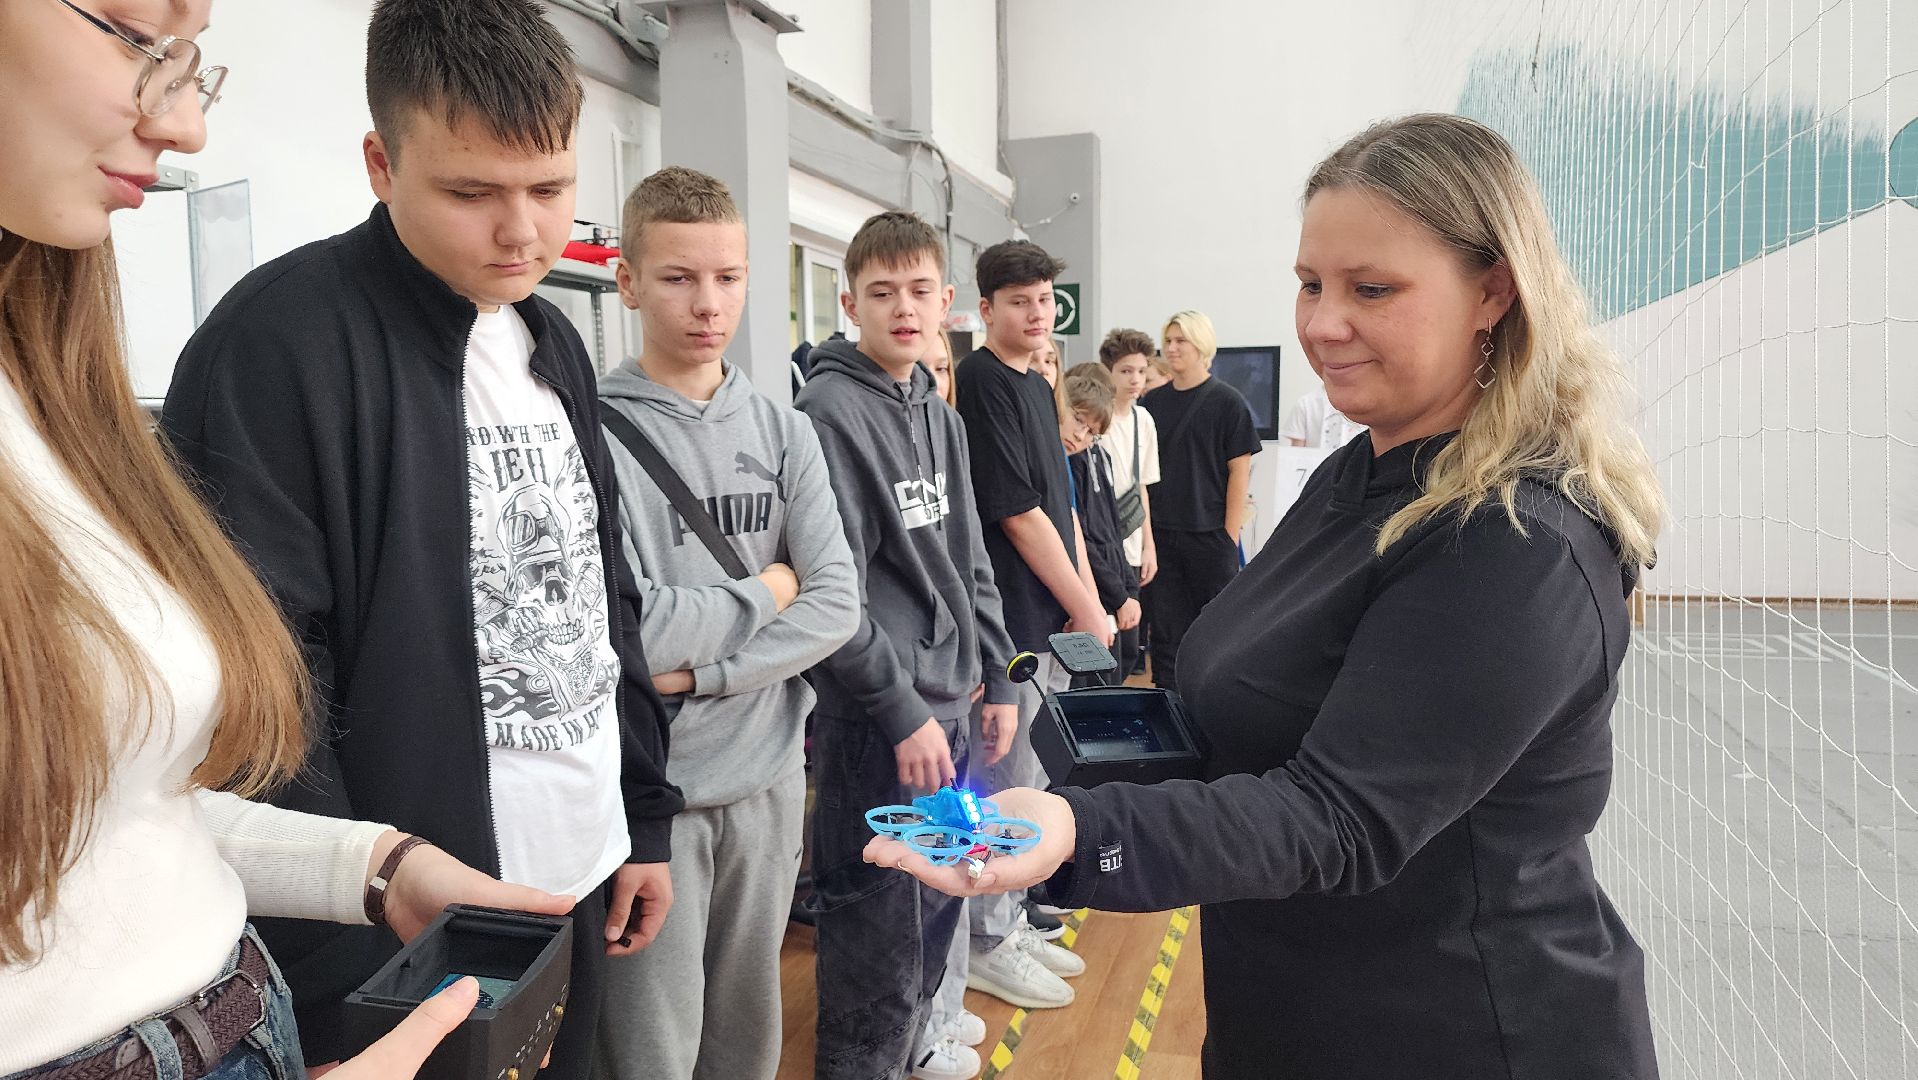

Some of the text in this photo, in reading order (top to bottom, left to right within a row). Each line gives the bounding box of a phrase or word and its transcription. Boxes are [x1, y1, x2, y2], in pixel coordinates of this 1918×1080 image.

[533, 422, 561, 442] THE
[1295, 468, 1307, 487] 7
[495, 719, 584, 751] MADE IN
